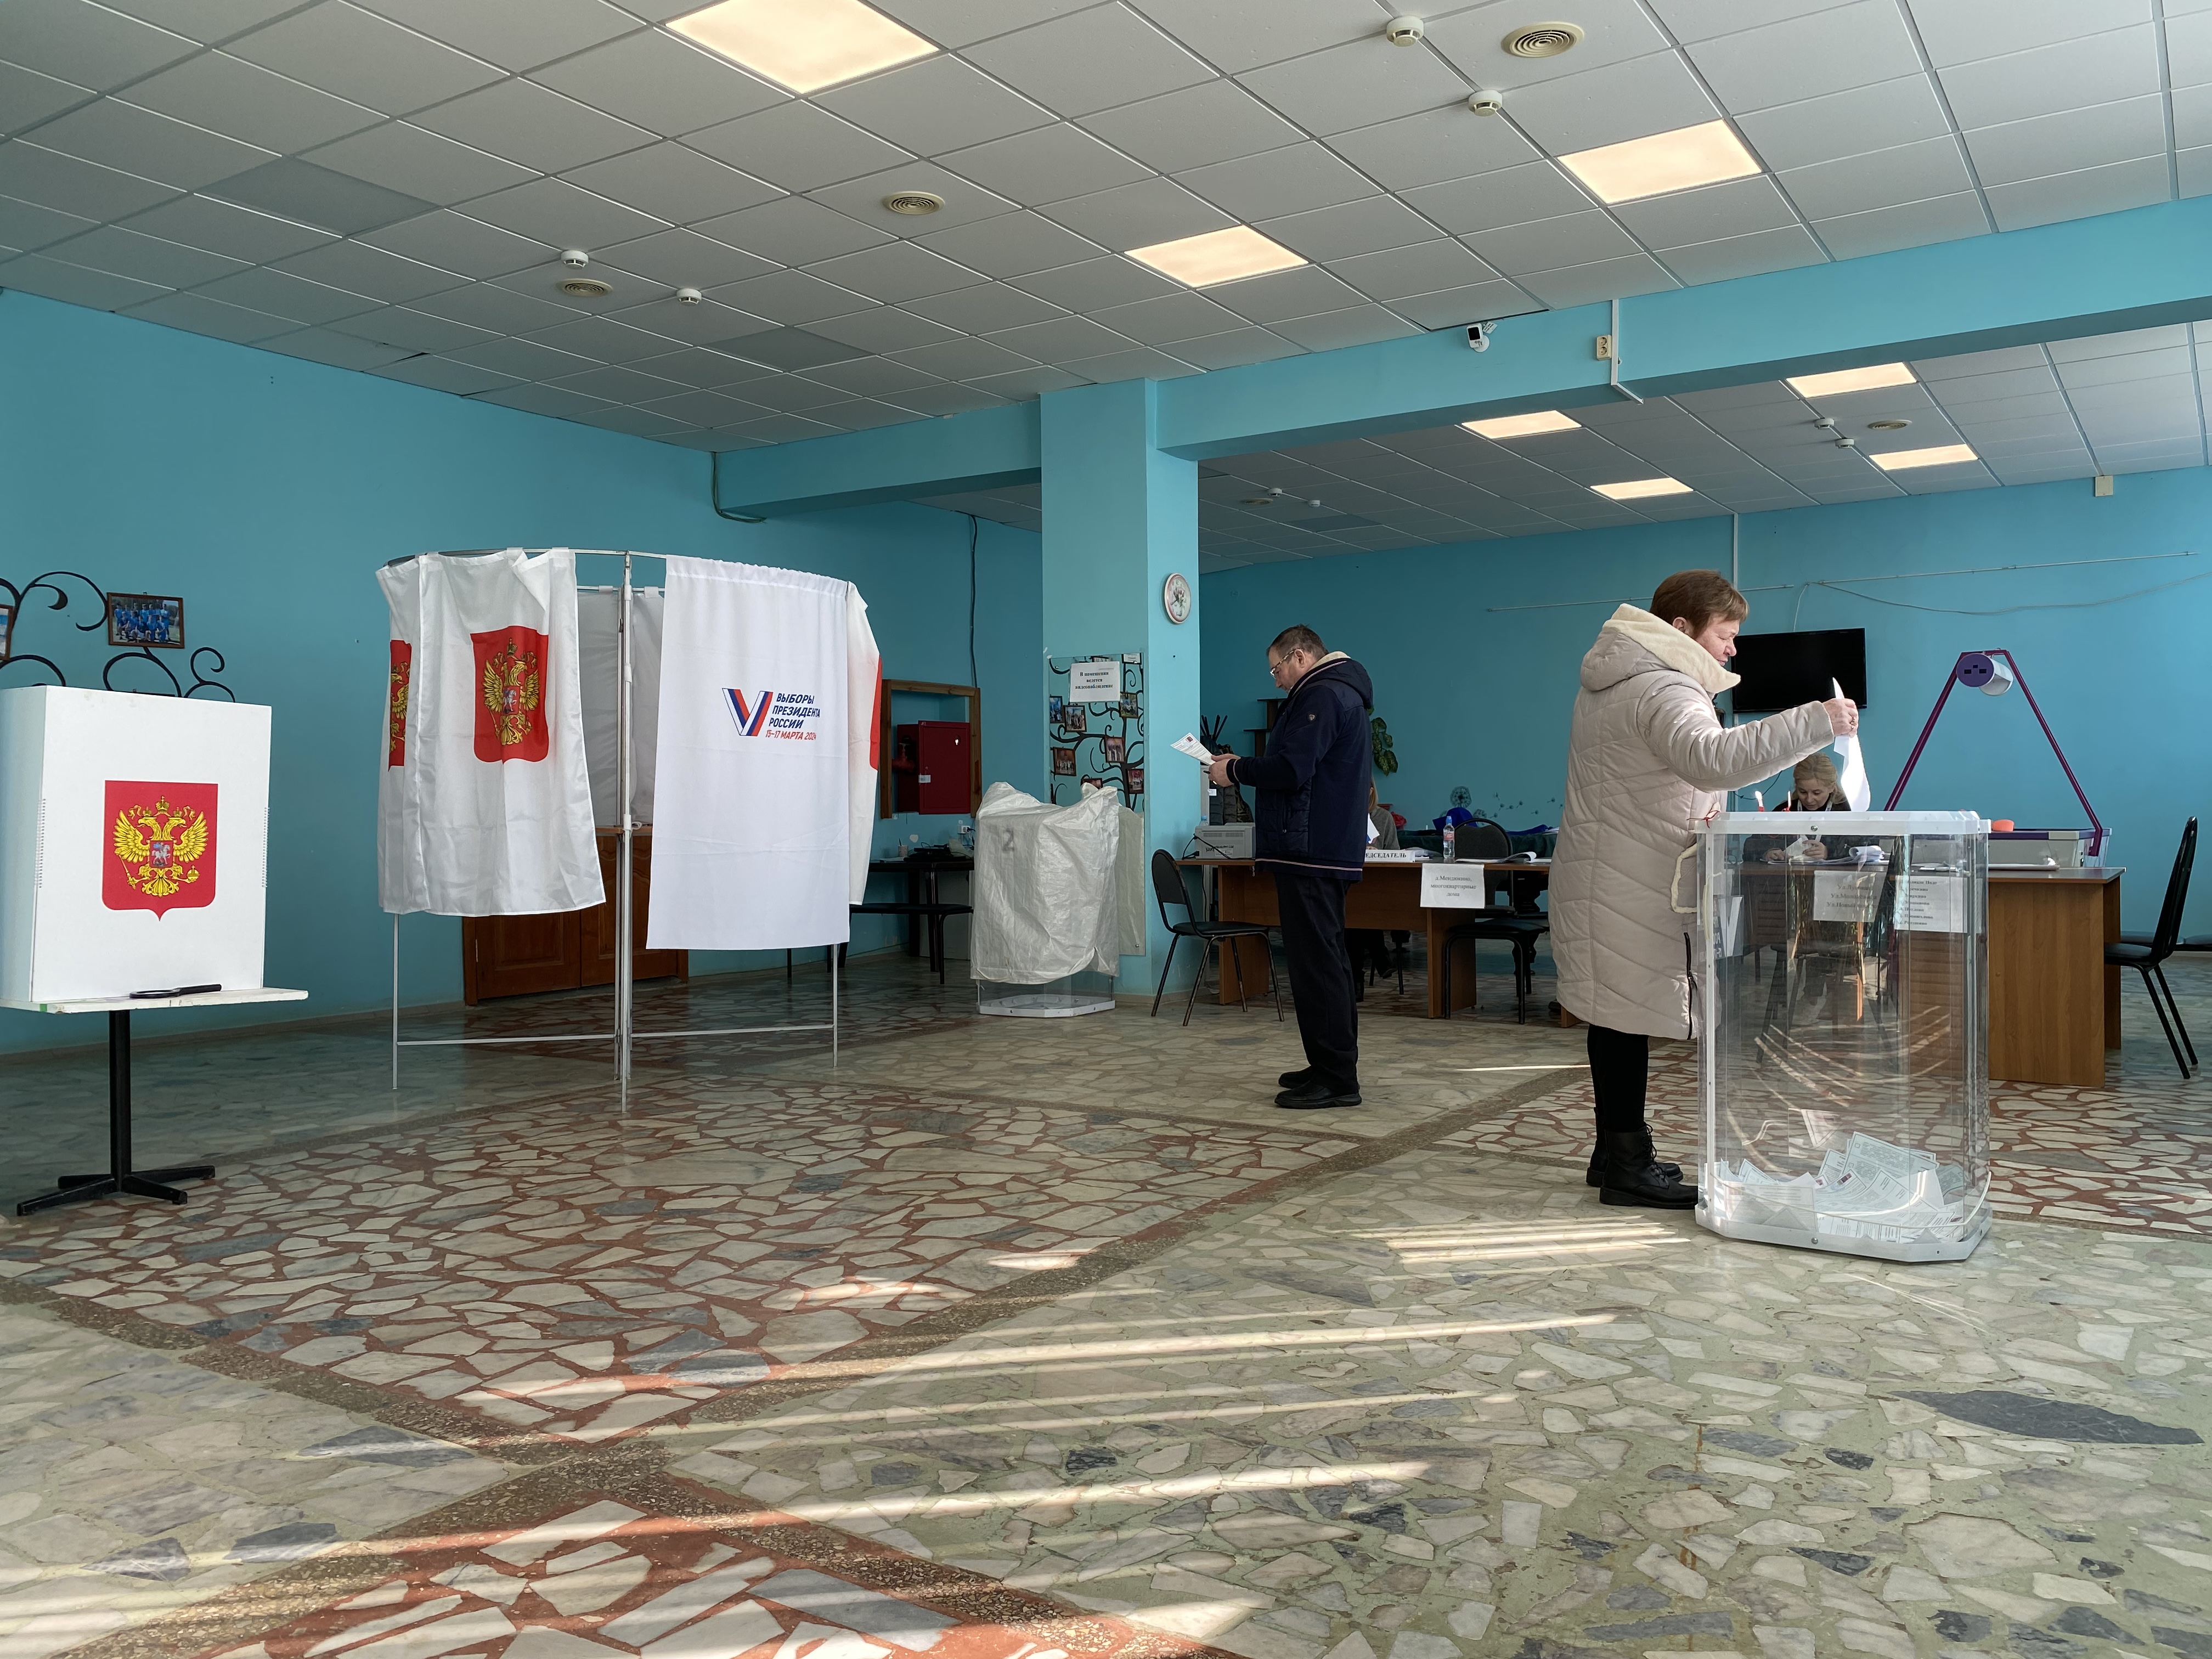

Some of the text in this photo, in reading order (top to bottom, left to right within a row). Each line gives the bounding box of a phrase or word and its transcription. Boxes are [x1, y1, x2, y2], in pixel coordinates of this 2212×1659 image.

[776, 693, 815, 704] ВЫБОРЫ
[772, 706, 820, 718] ПРЕЗИДЕНТА
[769, 717, 804, 729] РОССИИ
[781, 731, 804, 740] МАРТА
[804, 732, 817, 741] 2024
